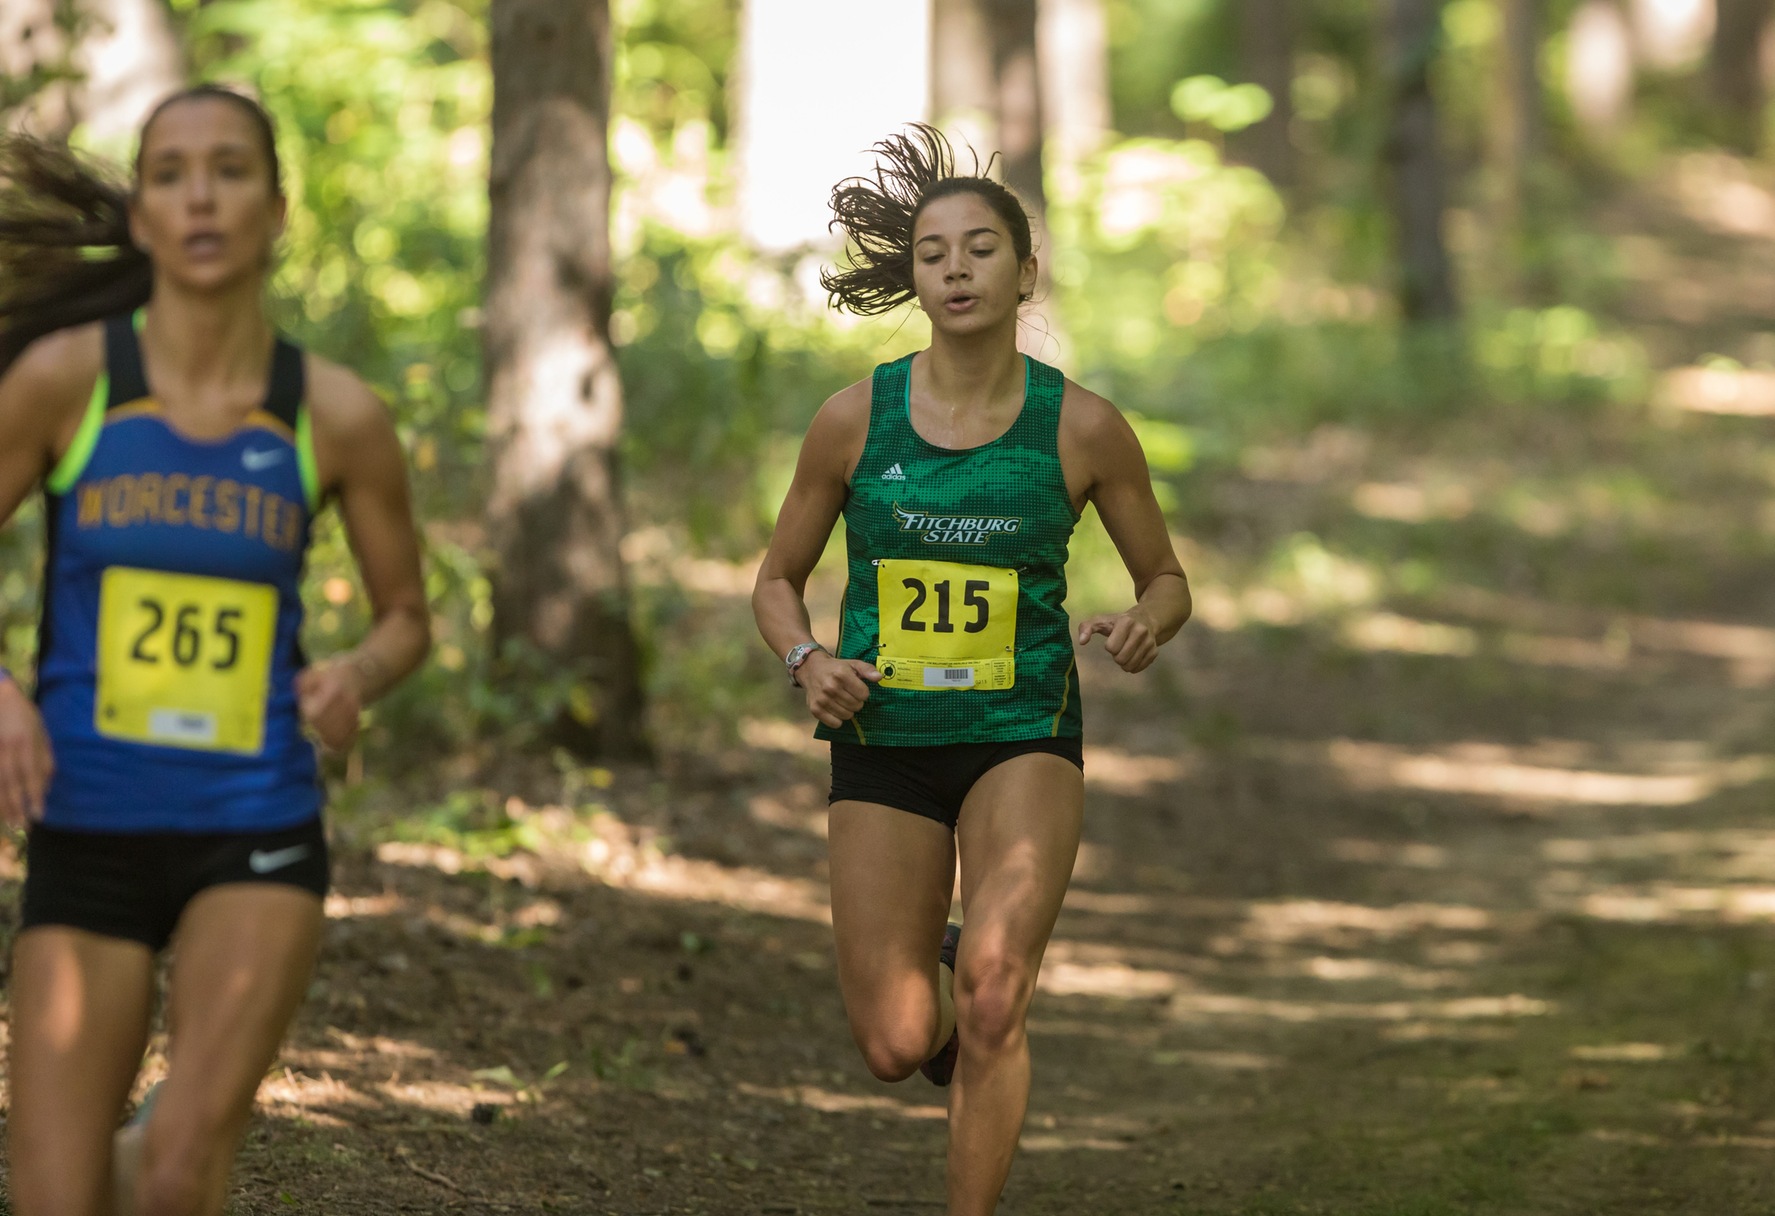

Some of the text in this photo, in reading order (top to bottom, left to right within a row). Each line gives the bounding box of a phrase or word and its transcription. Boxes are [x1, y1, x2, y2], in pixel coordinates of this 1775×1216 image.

[896, 508, 1019, 532] FITCHBURG
[923, 530, 989, 544] STATE
[901, 577, 990, 633] 215
[130, 597, 243, 672] 265
